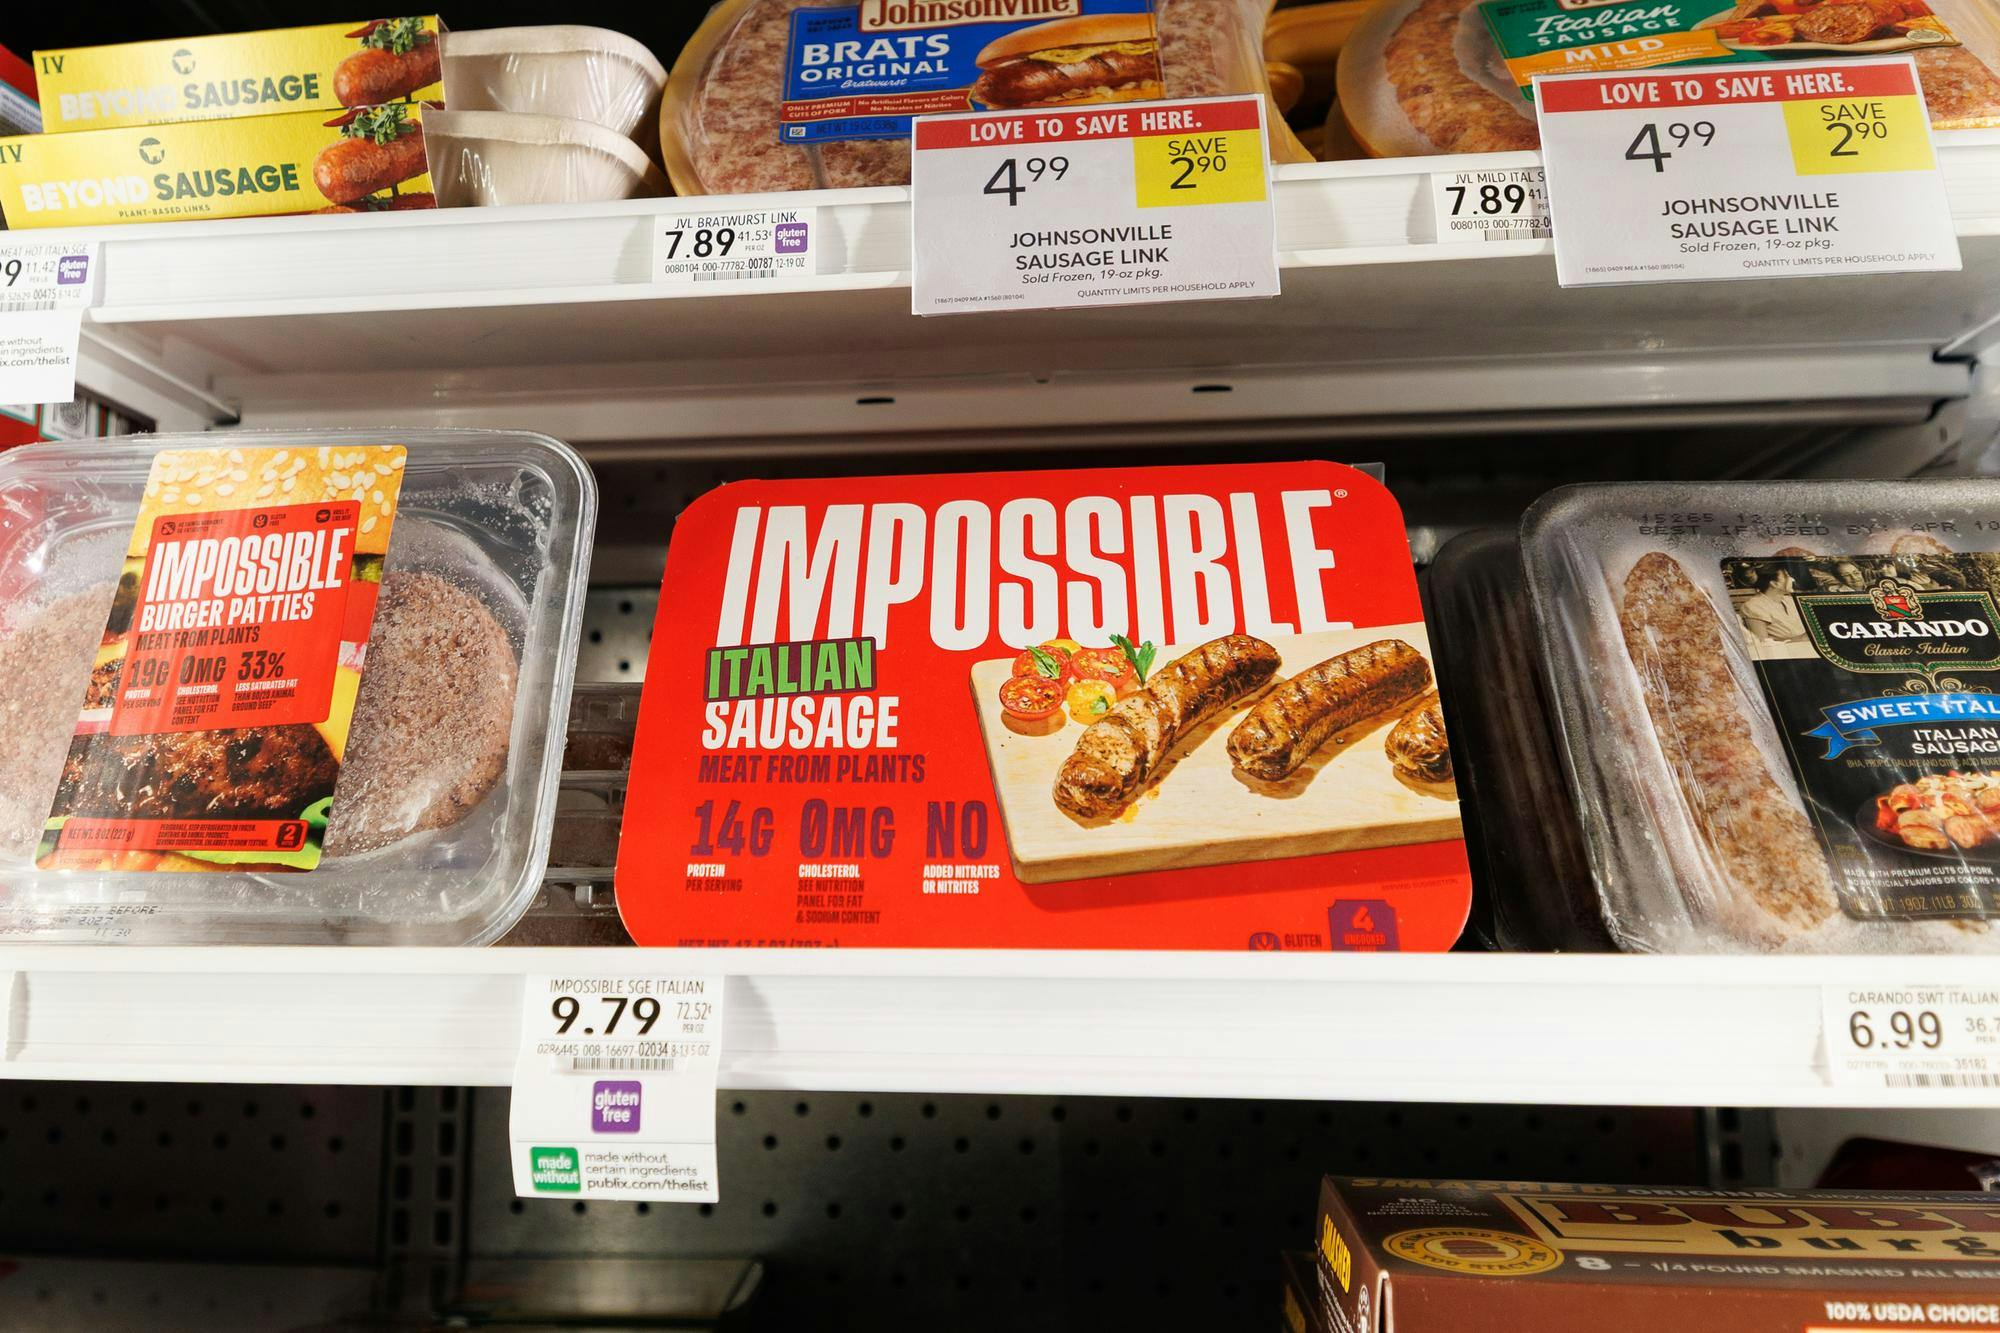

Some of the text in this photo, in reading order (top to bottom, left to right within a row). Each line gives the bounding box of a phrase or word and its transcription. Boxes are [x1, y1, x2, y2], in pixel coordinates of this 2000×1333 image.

[1528, 4, 1680, 37] Italian
[1537, 17, 1680, 46] SAUSAGE
[802, 33, 950, 66] BRATS
[1565, 38, 1665, 64] MILD
[800, 59, 949, 82] ORIGINAL
[841, 77, 907, 89] Bratwurst
[1601, 72, 1854, 105] LOVE TO SAVE HERE.
[59, 84, 177, 122] BEYOND
[183, 73, 319, 110] SAUSAGE
[787, 101, 850, 112] ONLY PREMIUM
[789, 110, 810, 118] CUTS
[823, 107, 847, 115] PORK
[1821, 102, 1886, 121] SAVE
[970, 110, 1202, 143] LOVE TO SAVE HERE.
[1168, 137, 1227, 156] SAVE
[20, 163, 301, 212] BEYOND SAUSAGE
[1456, 174, 1473, 184] JVL
[1477, 173, 1506, 183] MILD
[1511, 172, 1534, 182] ITAL
[1446, 184, 1525, 215] 7.89
[1662, 192, 1840, 217] JOHNSONVILLE
[119, 204, 211, 218] PLANT-BASED LINKS
[674, 211, 797, 229] JVL BRATWURST LINK
[777, 228, 805, 239] gluten
[1010, 224, 1173, 249] JOHNSONVILLE
[1670, 216, 1839, 239] SAUSAGE LINK
[665, 228, 736, 259] 7.89
[782, 238, 801, 247] free
[1680, 238, 1835, 253] Sold Frozen, 19-oz pkg.
[60, 260, 87, 272] gluten
[665, 263, 699, 273] 0080104
[702, 257, 773, 272] 000-77782-00787
[796, 257, 805, 267] OZ
[1016, 247, 1169, 271] SAUSAGE LINK
[1743, 252, 1936, 269] QUANTITY LIMITS PER HOUSEHOLD APPLY
[64, 270, 81, 280] free
[1022, 268, 1163, 285] Sold Frozen, 19-oz pkg.
[1077, 280, 1256, 299] QUANTITY LIMITS PER HOUSEHOLD APPLY
[1639, 525, 1700, 535] BEST
[1720, 525, 1748, 536] IF
[1766, 525, 1830, 536] USED
[1911, 521, 1957, 532] APR
[145, 528, 350, 603] IMPOSSIBLE
[715, 488, 1353, 652] IMPOSSIBLE
[139, 591, 315, 632] BURGER PATTIES
[135, 625, 261, 651] MEAT FROM PLANTS
[1829, 619, 1989, 640] CARANDO
[1864, 642, 1969, 657] Classic Italian
[127, 658, 170, 688] 19G
[179, 655, 227, 685] 0MG
[237, 650, 286, 681] 33%
[707, 640, 875, 696] ITALIAN
[124, 689, 151, 700] PROTEIN
[177, 684, 218, 695] CHOLESTEROL
[235, 679, 298, 691] LESS SATURATED FAT
[702, 696, 899, 749] SAUSAGE
[1837, 701, 1930, 725] SWEET
[1913, 727, 1998, 741] ITALIAN
[698, 754, 926, 783] MEAT FROM PLANTS
[284, 825, 297, 840] 2
[690, 800, 775, 857] 14G
[800, 798, 896, 859] 0MG
[925, 800, 989, 860] NO
[687, 864, 726, 878] PROTEIN
[798, 864, 860, 878] CHOLESTEROL
[923, 864, 1000, 878] ADDED NITRATES
[685, 879, 743, 892] PER SERVING
[798, 879, 865, 892] SEE NUTRITION
[922, 880, 980, 894] OR NITRITES
[796, 895, 863, 907] PANEL FOR FAT
[806, 911, 840, 924] SODIUM
[841, 911, 881, 924] CONTENT
[1352, 906, 1375, 932] 4
[1285, 934, 1322, 948] GLUTEN
[550, 979, 704, 994] IMPOSSIBLE SGE ITALIAN
[1849, 992, 1999, 1004] CARANDO SWT ITALIAN
[552, 997, 661, 1035] 9.79
[1850, 1010, 1943, 1049] 6.99
[595, 1089, 639, 1110] gluten
[602, 1107, 631, 1123] free
[538, 1154, 572, 1170] made
[585, 1152, 668, 1164] made without
[533, 1169, 579, 1185] without
[585, 1164, 698, 1178] certain ingredients
[587, 1178, 709, 1193] publix.com/thelist
[1352, 1178, 1617, 1195] SMASHED
[1628, 1187, 1797, 1199] ORIGINAL
[1321, 1213, 1351, 1295] SMASHED
[1575, 1256, 1612, 1271] 8
[1651, 1262, 1688, 1273] 1/4
[1694, 1264, 1780, 1276] POUND
[1784, 1266, 1904, 1278] SMASHED
[1912, 1268, 1954, 1278] ALL
[1825, 1302, 1999, 1323] 100% USDA CHOICE
